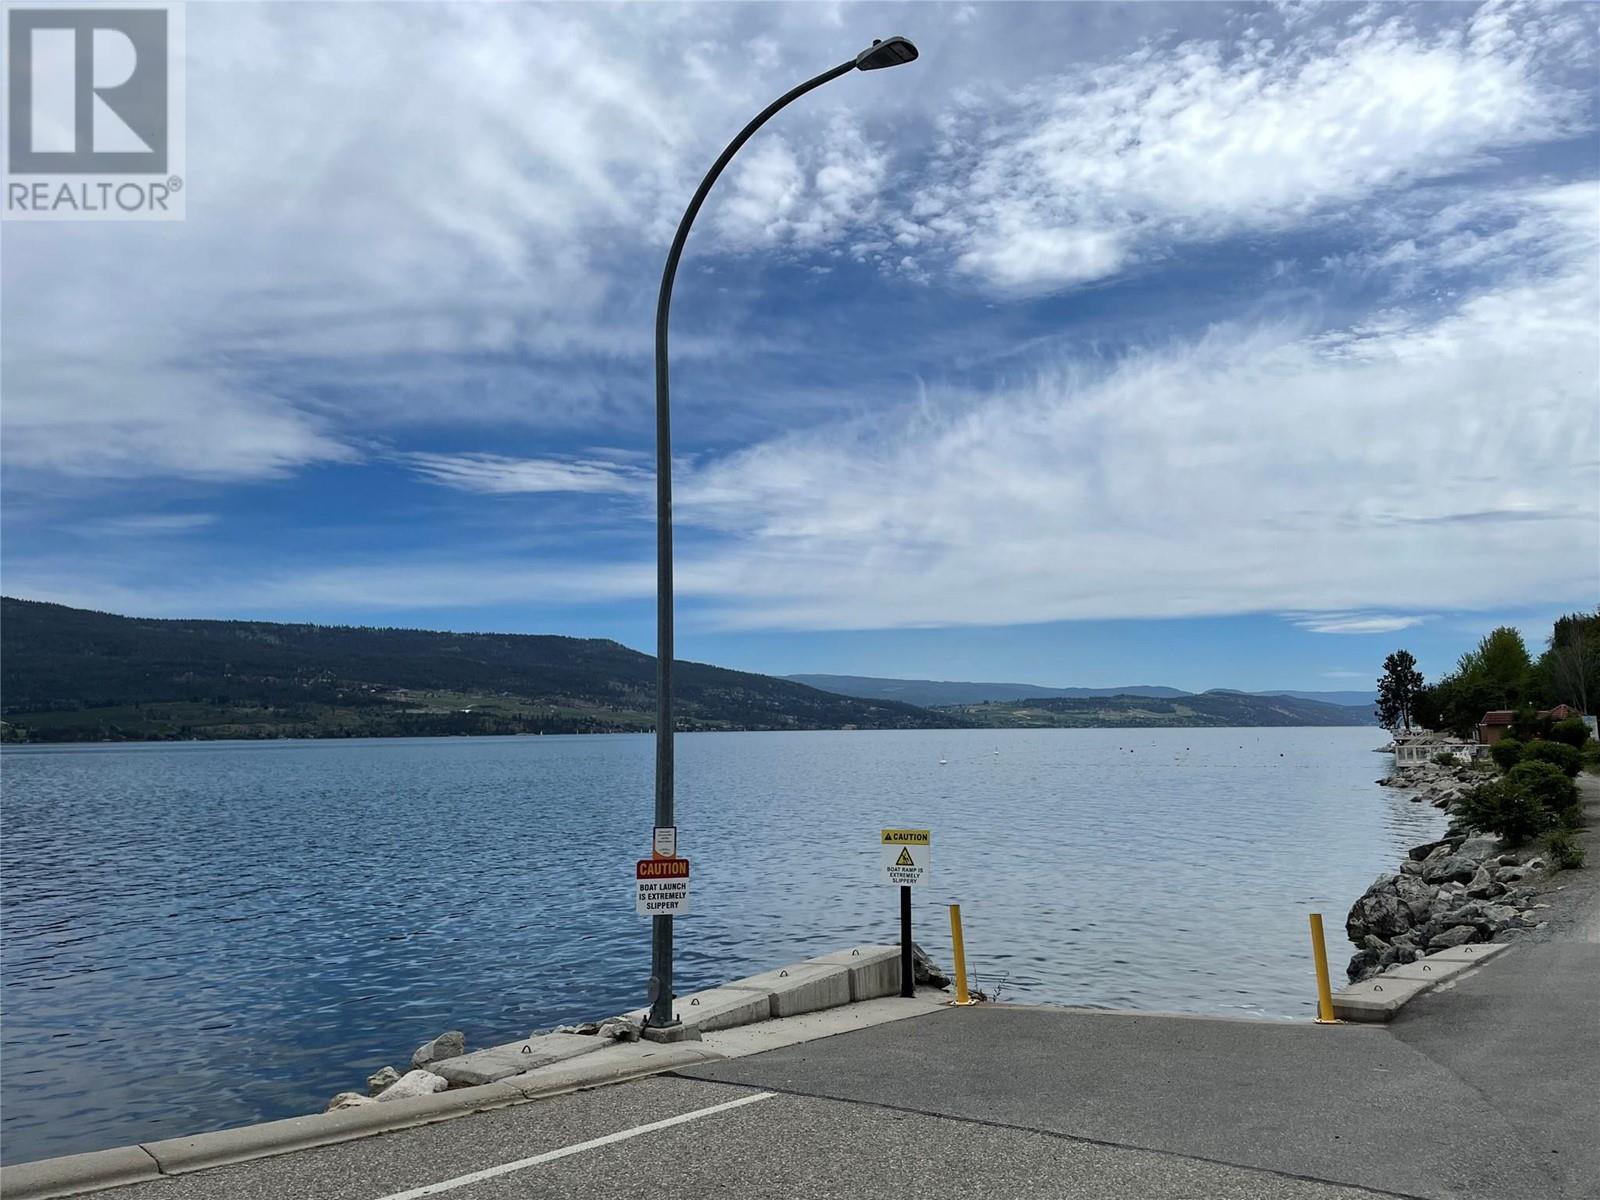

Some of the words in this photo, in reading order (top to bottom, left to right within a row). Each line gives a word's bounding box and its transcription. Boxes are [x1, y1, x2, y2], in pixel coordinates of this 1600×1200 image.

[893, 833, 928, 841] CAUTION
[640, 862, 687, 875] CAUTION
[647, 892, 686, 900] EXTREMELY
